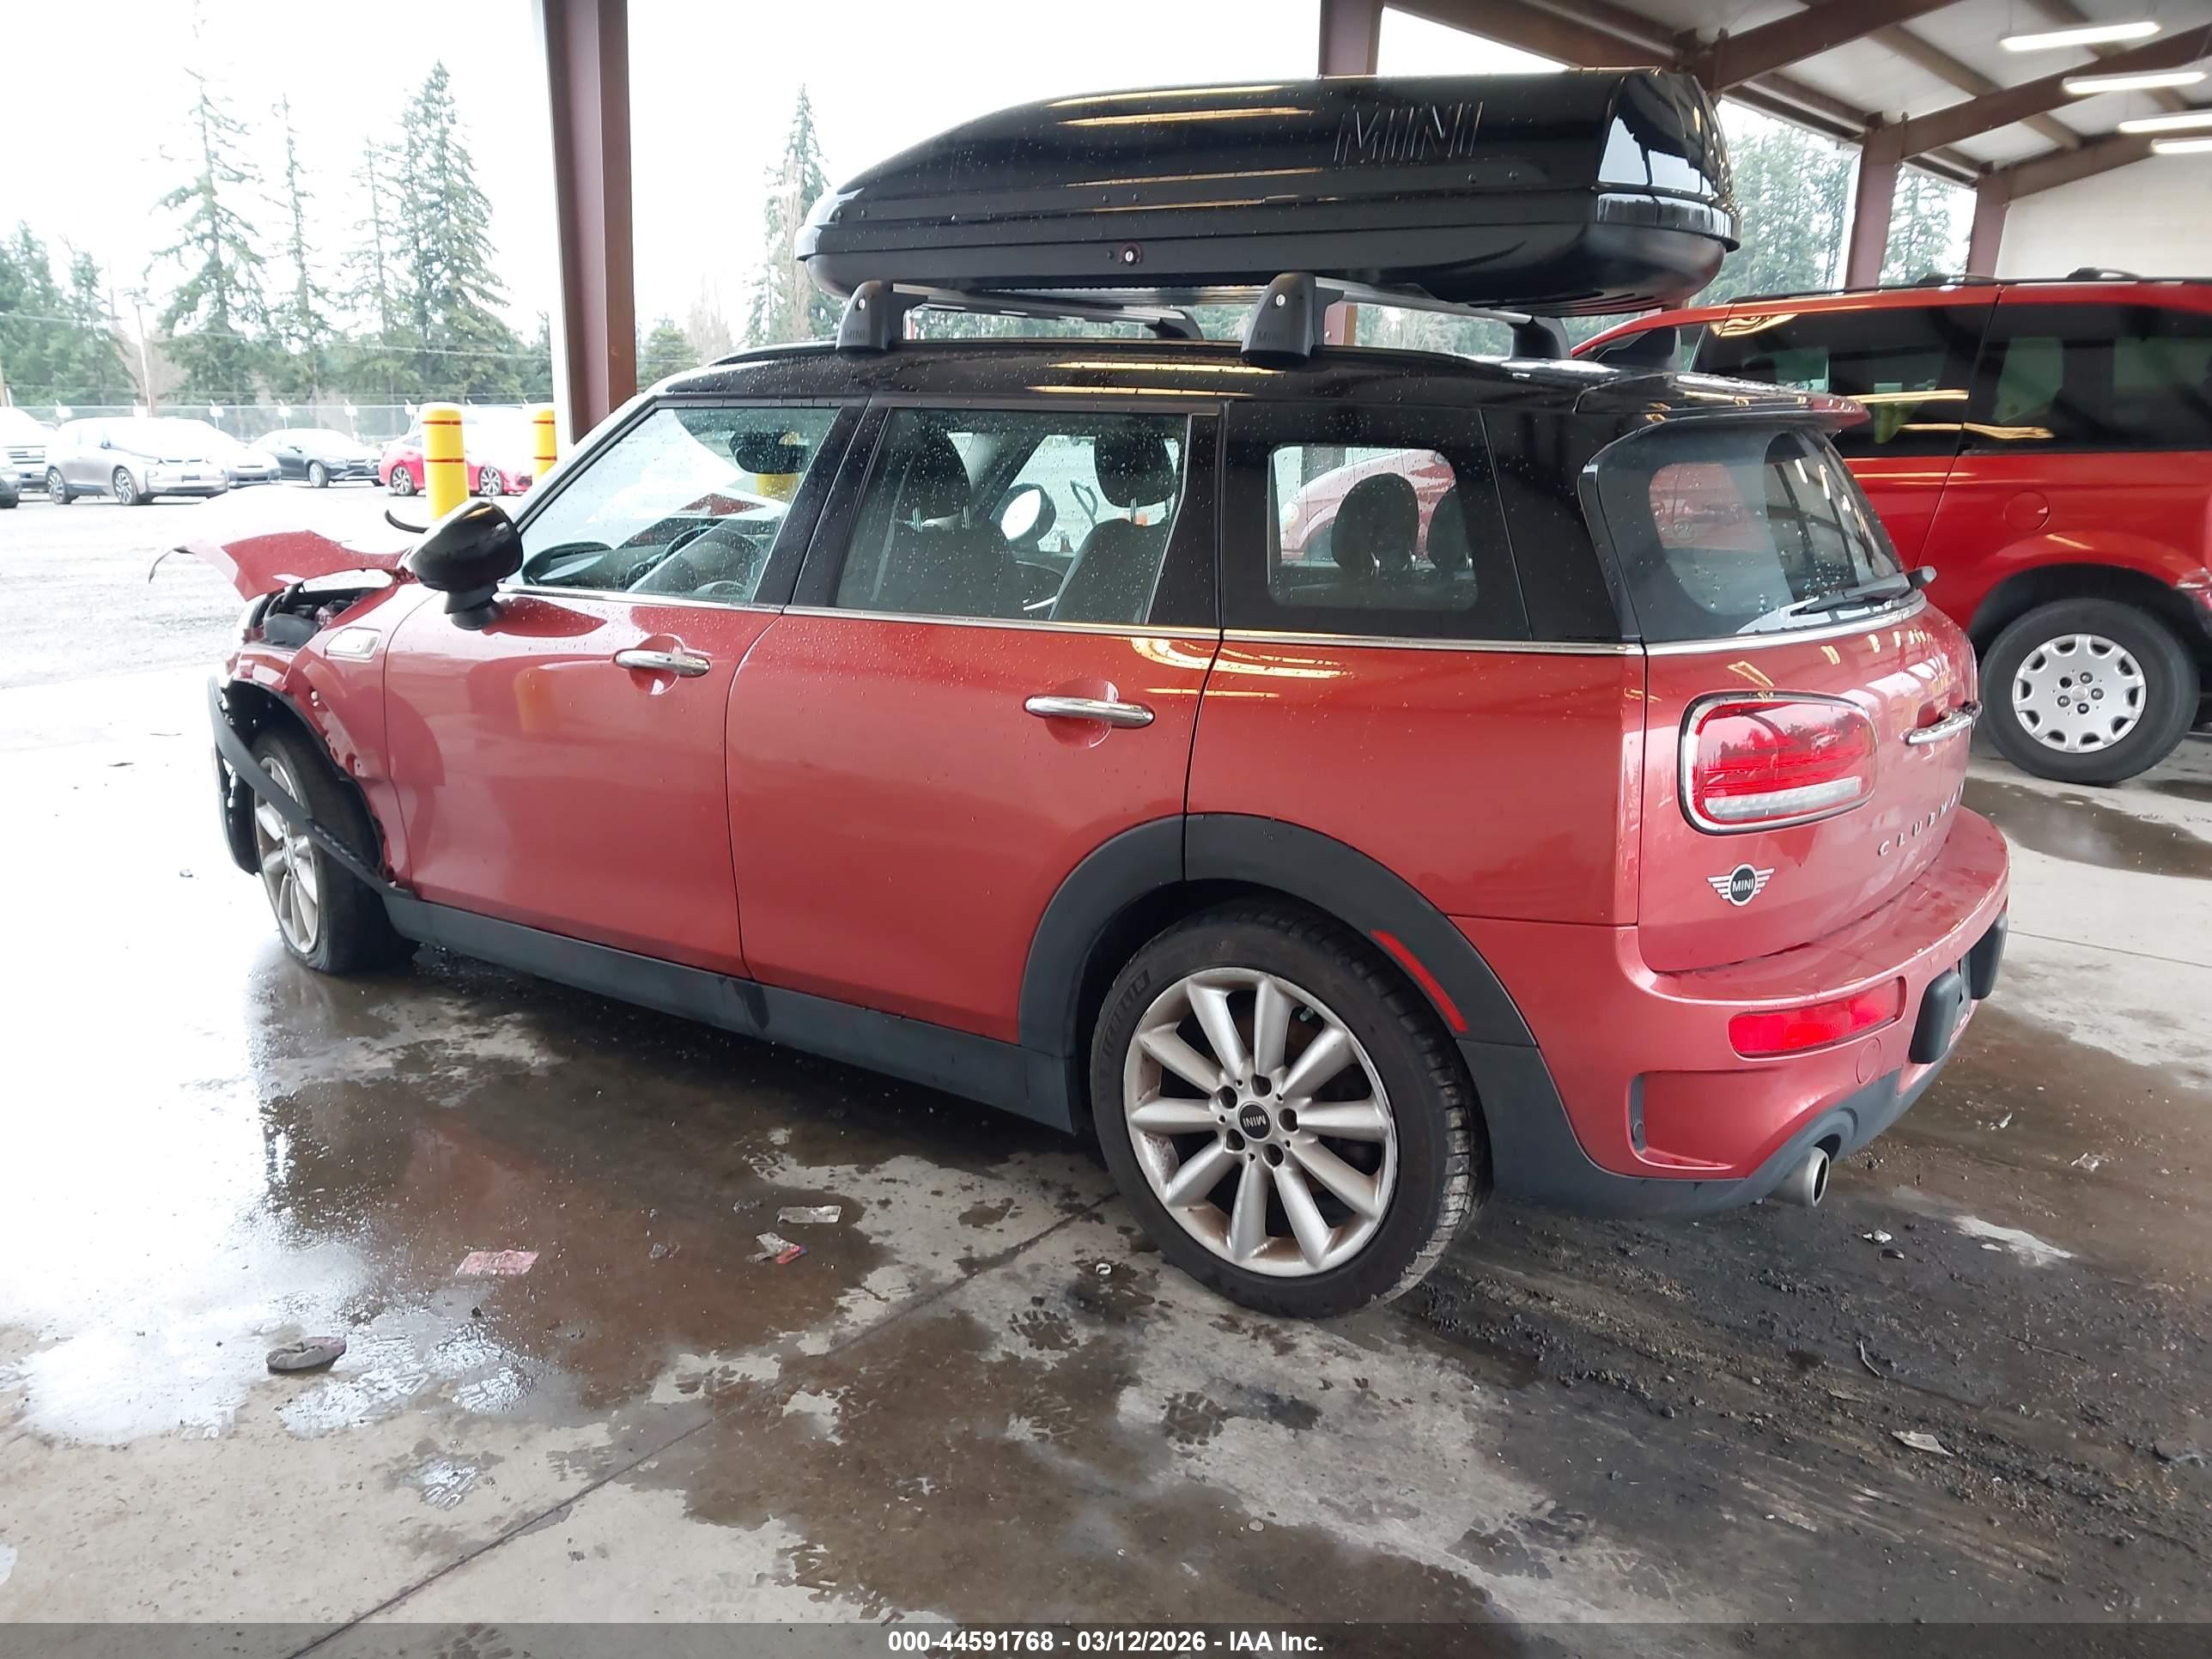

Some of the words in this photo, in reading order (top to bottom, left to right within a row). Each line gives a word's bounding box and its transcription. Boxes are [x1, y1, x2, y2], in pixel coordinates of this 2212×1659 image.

[1331, 100, 1484, 163] MINI
[1731, 878, 1754, 893] MINI
[1100, 969, 1149, 1060] ICHELIN
[1243, 1115, 1267, 1127] MINI
